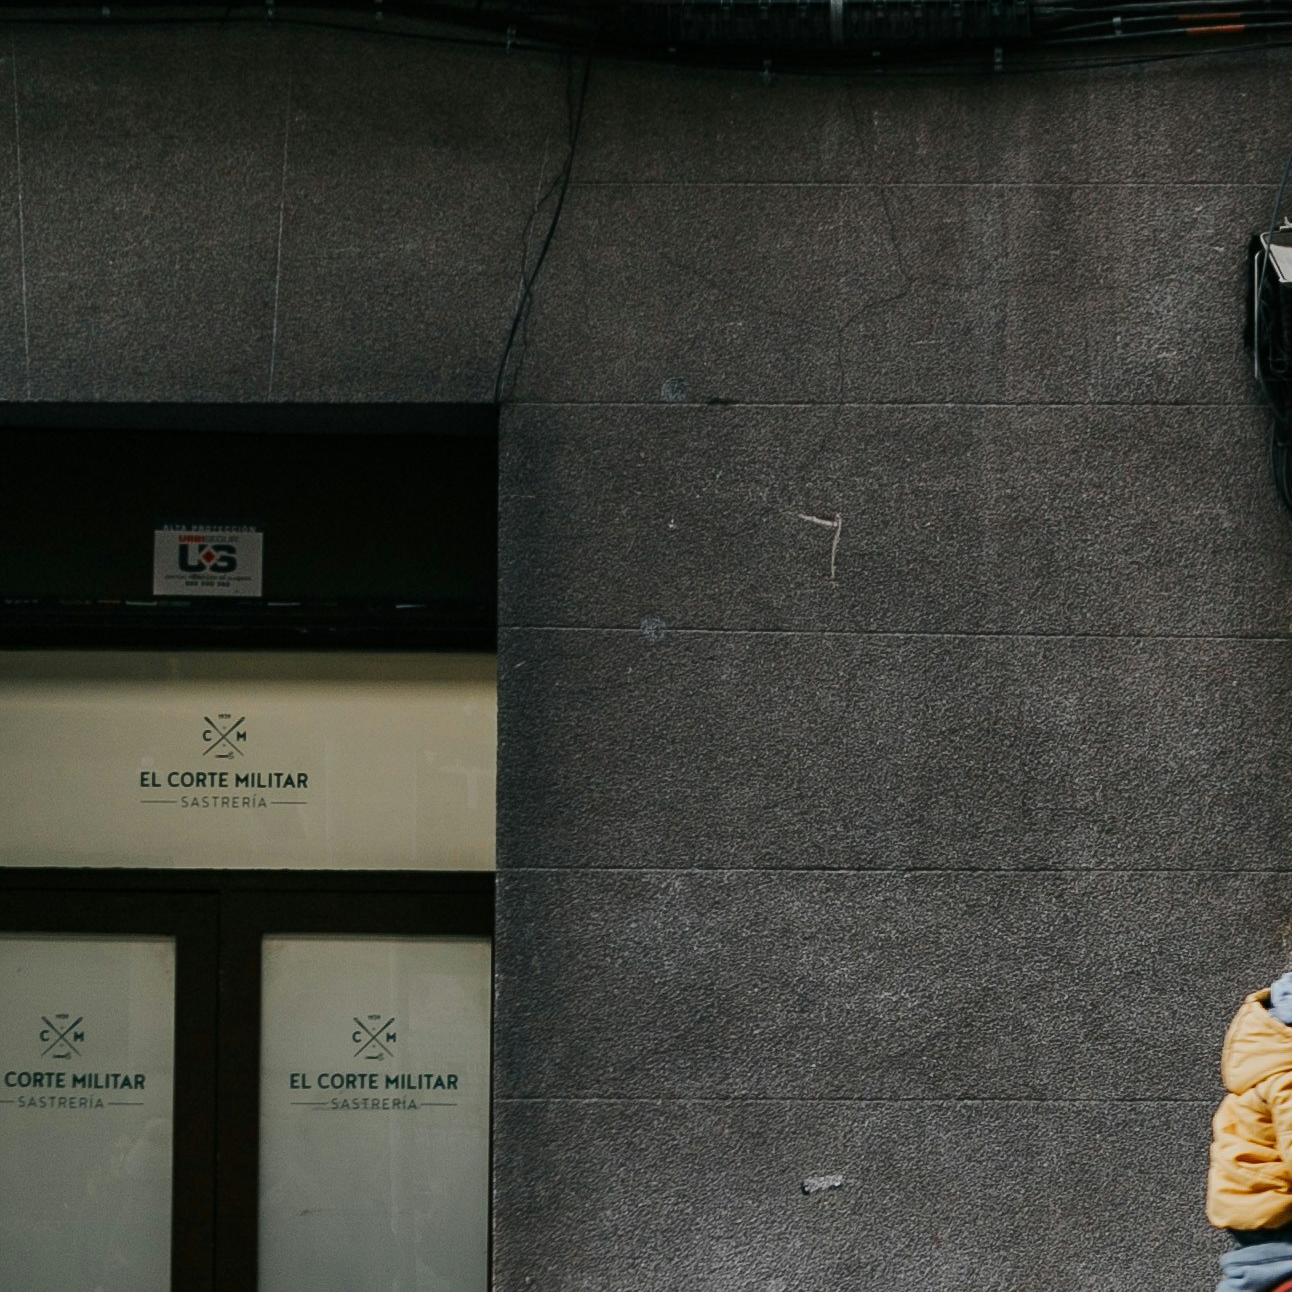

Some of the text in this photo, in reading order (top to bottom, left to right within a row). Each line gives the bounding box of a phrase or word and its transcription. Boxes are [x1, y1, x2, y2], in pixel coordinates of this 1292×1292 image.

[202, 729, 247, 742] C M
[140, 771, 309, 789] EL CORTE MILITAR
[180, 794, 268, 809] SASTRERÍA
[39, 1029, 85, 1042] C M
[352, 1030, 397, 1043] C M
[4, 1071, 146, 1089] CORTE MILITAR
[290, 1072, 459, 1090] EL CORTE MILITAR
[17, 1094, 104, 1109] SASTRERÍA
[330, 1094, 418, 1110] SASTRERÍA
